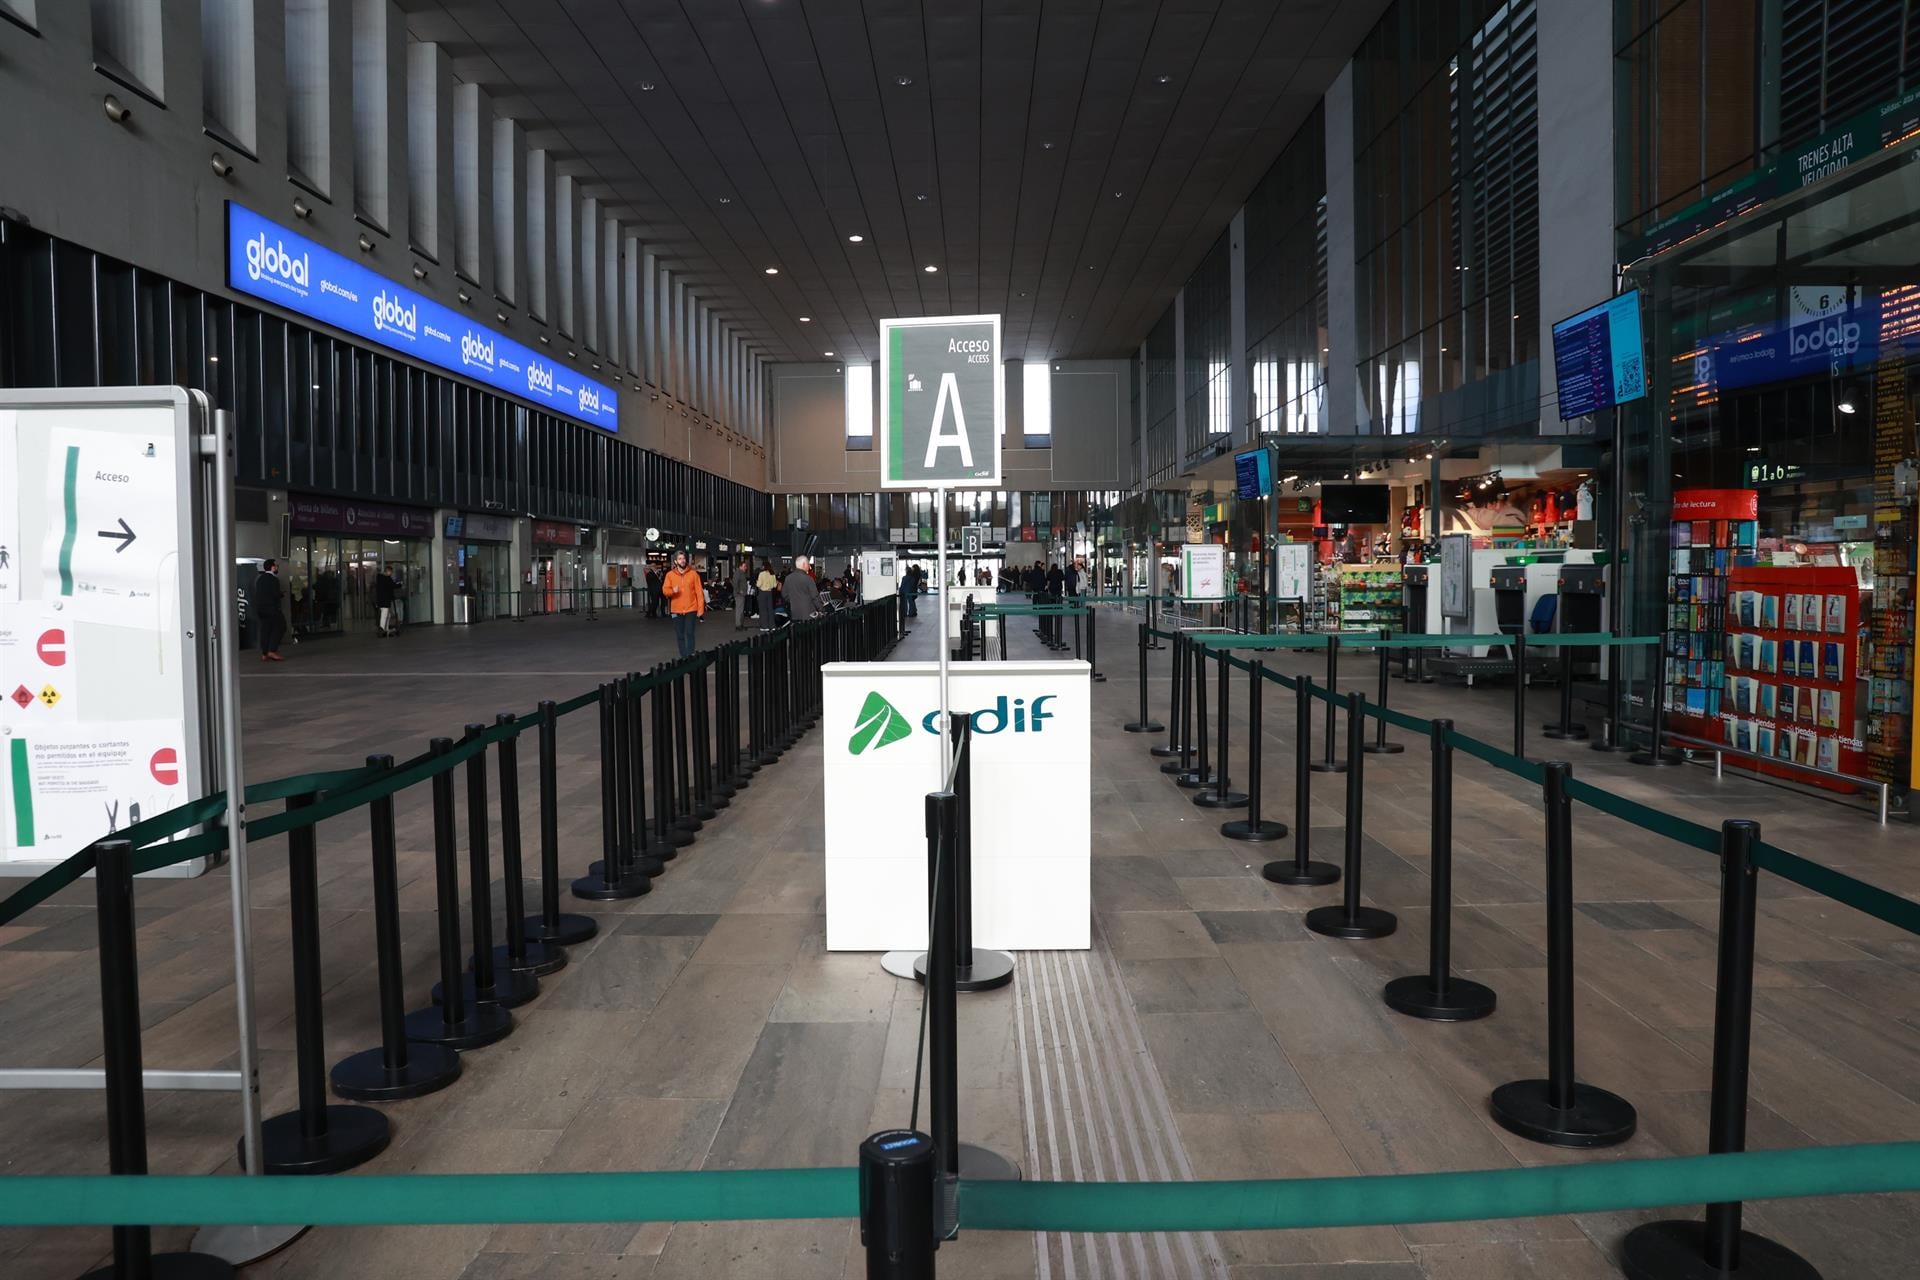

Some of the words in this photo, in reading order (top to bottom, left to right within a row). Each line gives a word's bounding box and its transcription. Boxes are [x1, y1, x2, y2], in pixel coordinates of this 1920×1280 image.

[1798, 143, 1829, 173] TRENES
[1831, 132, 1854, 157] ALTA
[246, 231, 309, 287] global
[320, 278, 358, 303] global.com/es
[372, 289, 416, 333] global
[1820, 294, 1830, 310] 6
[461, 329, 494, 366] global
[948, 337, 990, 353] Acceso
[967, 354, 990, 364] ACCESS
[527, 360, 553, 391] global
[579, 384, 599, 412] global
[924, 372, 974, 468] A
[95, 470, 130, 484] Acceso
[1761, 464, 1769, 482] 1
[1776, 464, 1785, 480] 6
[969, 535, 977, 553] B
[1795, 726, 1817, 738] tiendas
[1838, 734, 1864, 748] tiendas
[98, 750, 127, 759] equipaje
